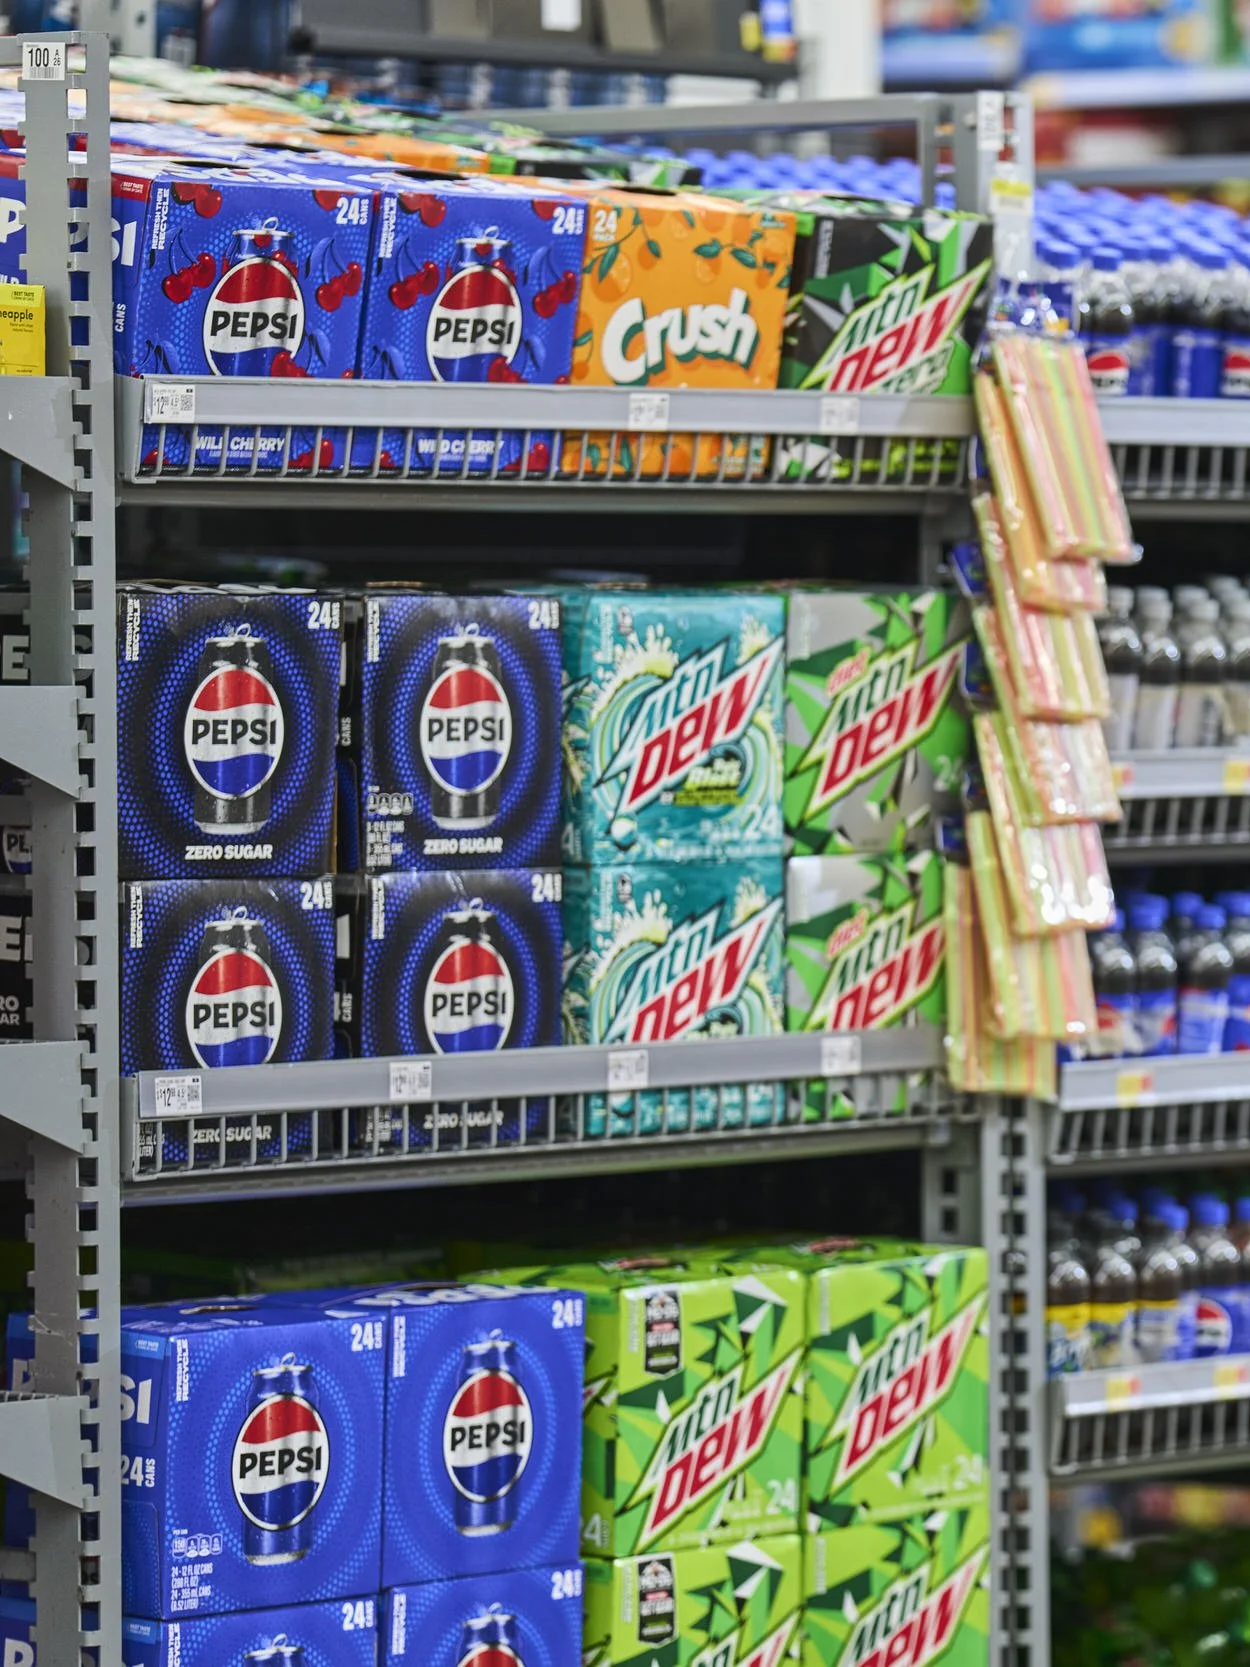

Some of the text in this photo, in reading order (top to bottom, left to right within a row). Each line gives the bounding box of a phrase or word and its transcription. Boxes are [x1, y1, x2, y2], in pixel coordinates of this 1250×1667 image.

[28, 48, 49, 67] 100
[158, 188, 170, 250] RECYCLE
[336, 198, 369, 225] 24 CANS
[552, 207, 575, 235] 24
[593, 210, 617, 233] 24
[115, 303, 126, 333] CANS
[210, 310, 298, 339] PEPSI
[433, 317, 516, 345] PEPSI
[602, 288, 759, 383] Crush
[230, 437, 285, 451] CHRRY
[132, 598, 141, 661] RECYCLE
[308, 601, 332, 630] 24
[528, 601, 551, 630] 24
[191, 719, 277, 745] PEPSI
[341, 717, 351, 747] CANS
[428, 717, 505, 742] PEPSI
[185, 844, 273, 860] ZERO SUGAR
[423, 836, 503, 855] ZERO SUGAR
[301, 881, 325, 910] 24
[532, 873, 554, 902] 24
[193, 1001, 275, 1030] PEPSI
[432, 991, 506, 1018] PEPSI
[553, 1299, 575, 1329] 24
[351, 1323, 374, 1352] 24
[374, 1321, 383, 1350] CANS
[450, 1421, 526, 1451] PEPSI
[121, 1456, 156, 1488] 24 CANS
[239, 1446, 322, 1479] PEPSI
[766, 1478, 797, 1514] 24
[582, 1513, 600, 1547] 4
[551, 1571, 573, 1600] 24
[343, 1602, 364, 1631] 24
